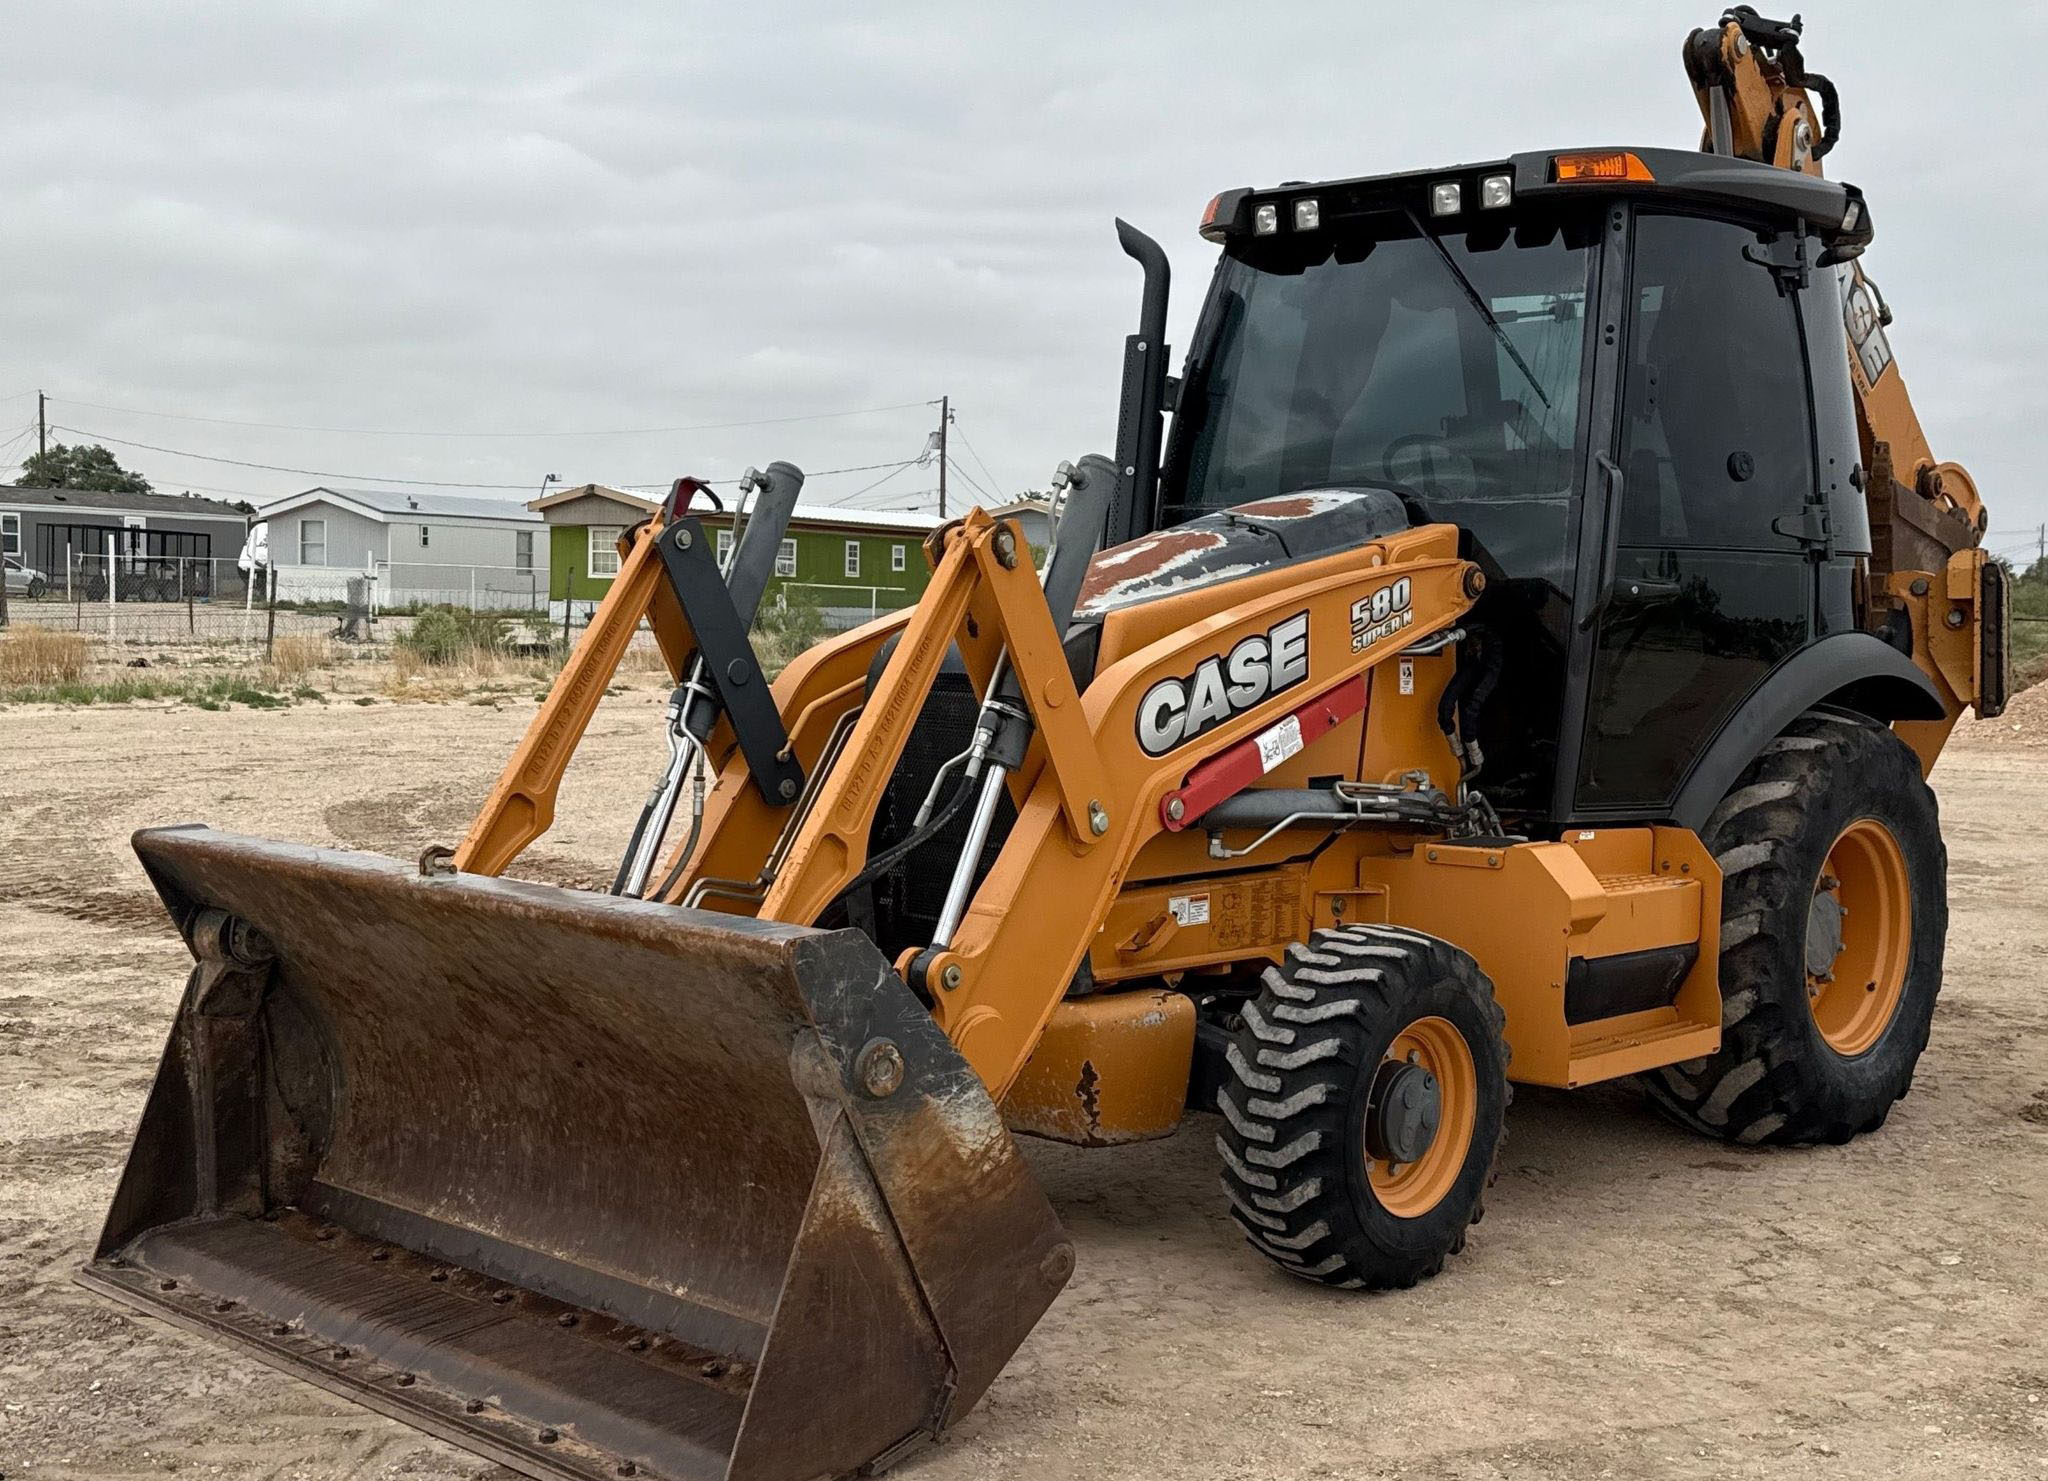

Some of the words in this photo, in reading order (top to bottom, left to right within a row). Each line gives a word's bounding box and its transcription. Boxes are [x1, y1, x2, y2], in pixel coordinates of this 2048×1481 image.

[1351, 576, 1412, 635] 580
[1352, 616, 1401, 653] SUPER
[1402, 608, 1413, 627] N
[1136, 610, 1310, 756] CASE
